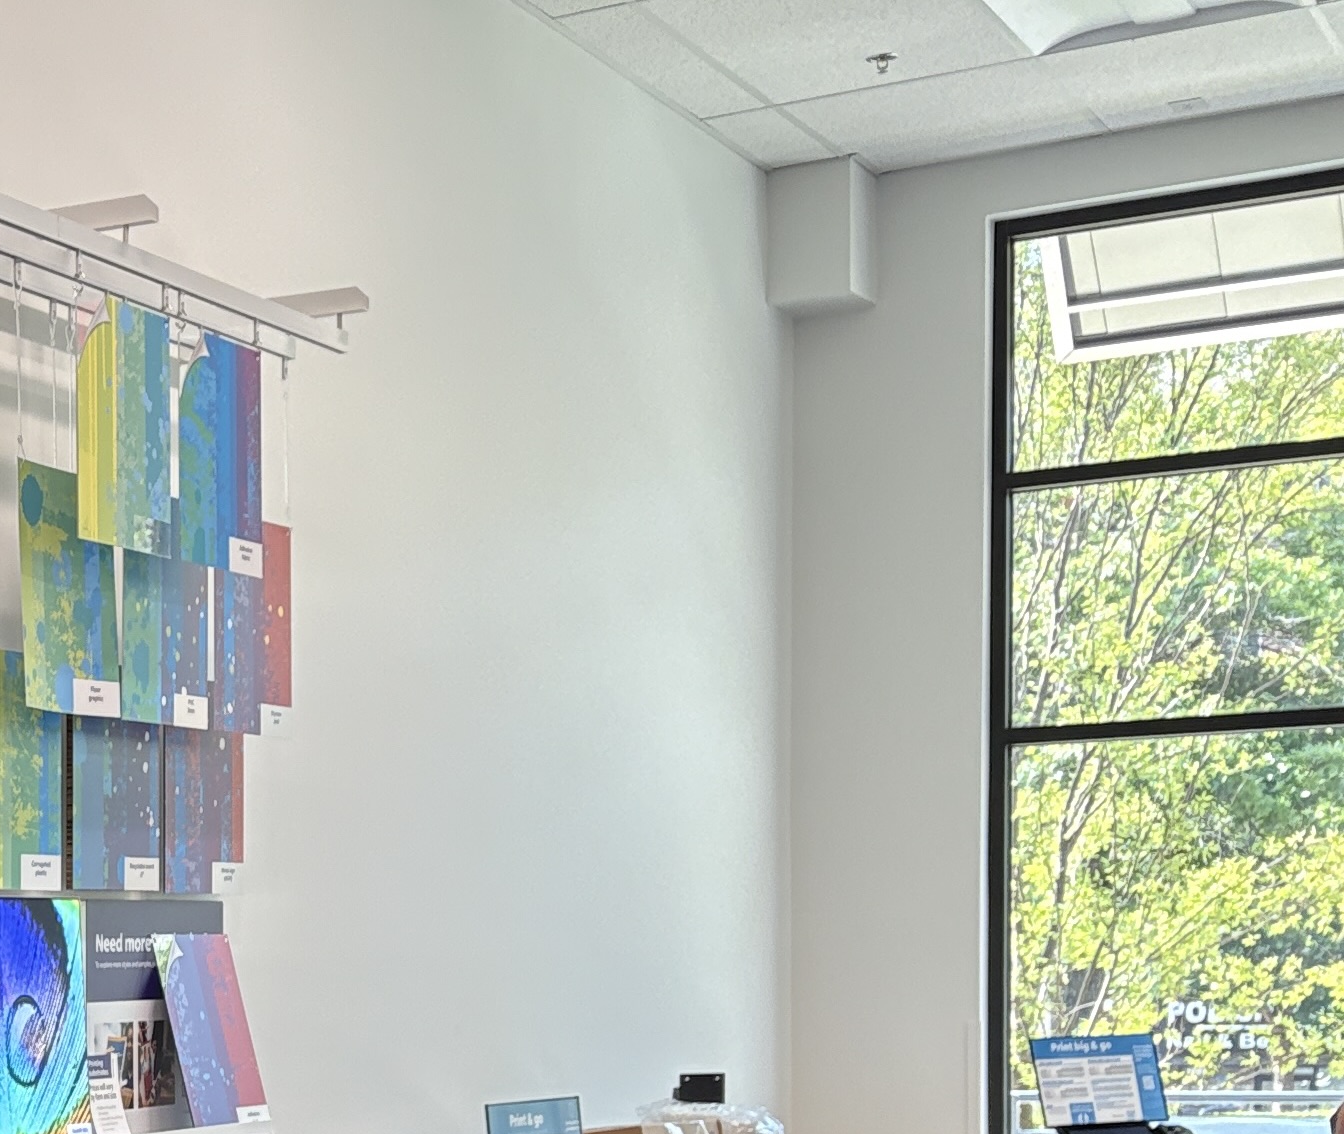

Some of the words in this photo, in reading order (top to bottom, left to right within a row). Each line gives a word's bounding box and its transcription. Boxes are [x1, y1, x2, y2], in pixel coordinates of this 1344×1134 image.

[95, 933, 123, 953] Need
[124, 935, 152, 952] more
[534, 1113, 544, 1128] go
